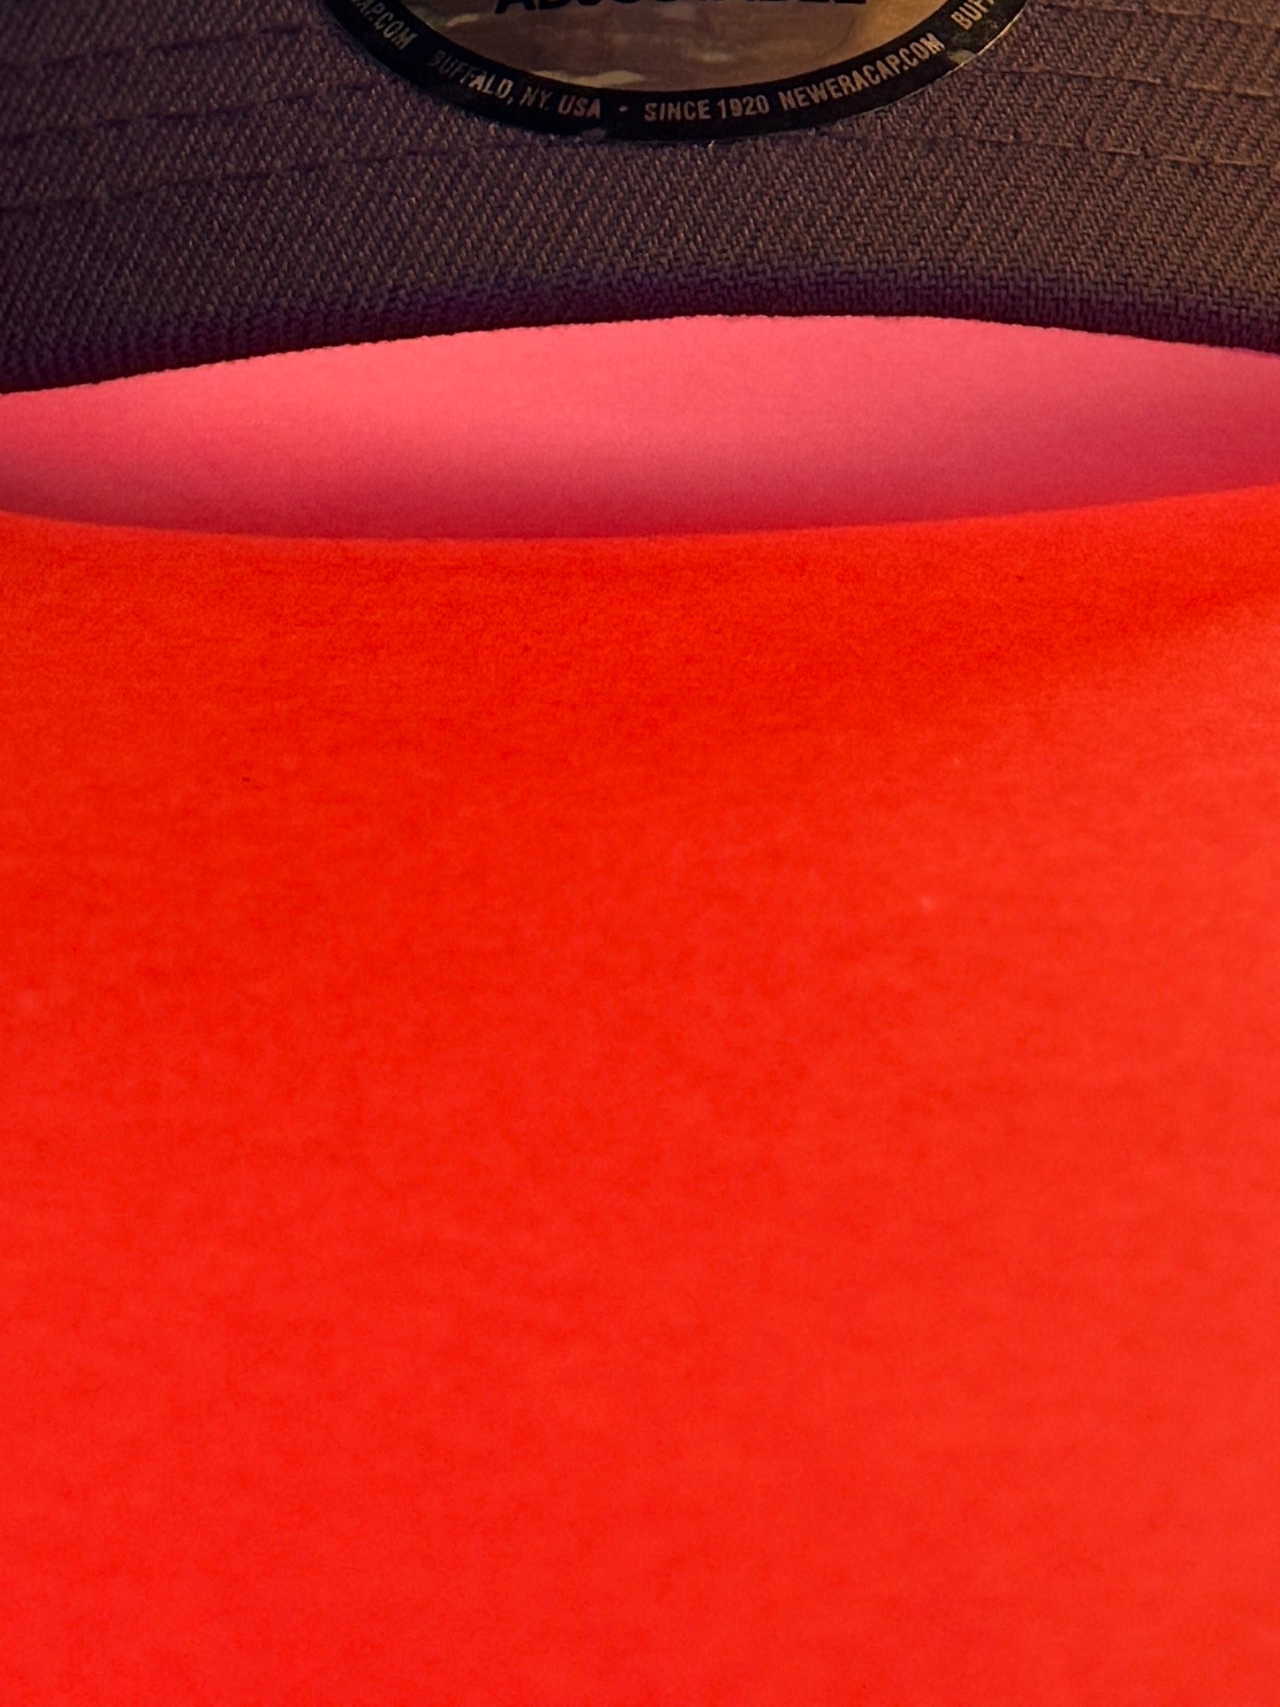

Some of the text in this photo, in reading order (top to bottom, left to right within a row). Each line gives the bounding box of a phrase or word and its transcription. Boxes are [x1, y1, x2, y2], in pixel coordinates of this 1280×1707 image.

[426, 49, 515, 105] BUFFALO,
[556, 94, 602, 122] USA
[642, 99, 711, 124] SINCE
[718, 94, 770, 120] 1920
[778, 32, 946, 111] NEWERACAP.COM
